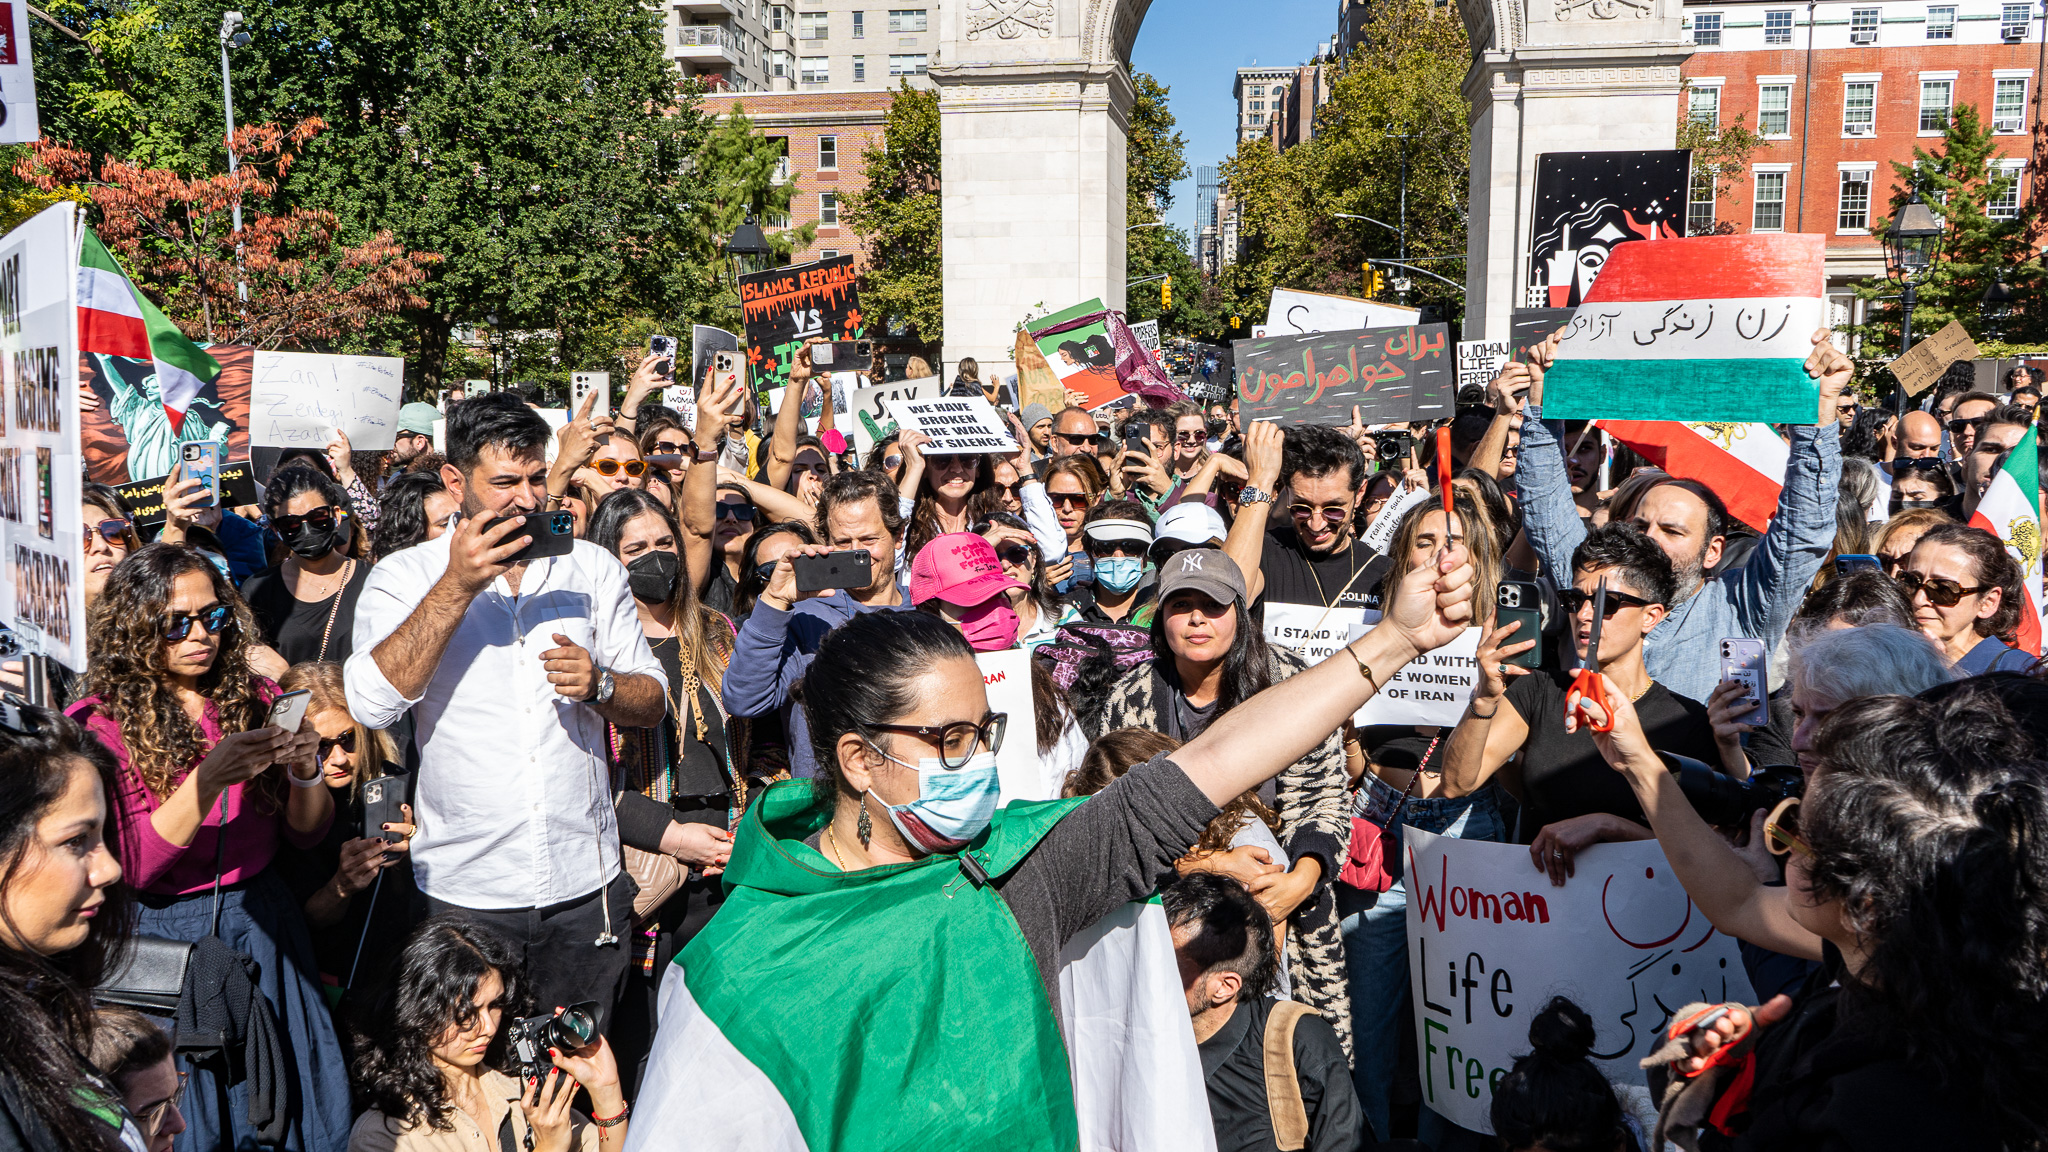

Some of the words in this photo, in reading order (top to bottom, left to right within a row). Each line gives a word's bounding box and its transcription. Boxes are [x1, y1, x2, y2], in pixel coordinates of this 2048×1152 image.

[740, 277, 796, 301] ISLAMIC
[798, 263, 856, 290] REPUBLIC
[790, 308, 823, 334] VS
[1562, 310, 1622, 342] آزادی
[1633, 303, 1714, 346] زندگی
[1736, 304, 1791, 341] زن
[1384, 325, 1445, 361] برای
[1459, 341, 1509, 359] WOMAN
[259, 356, 320, 388] Zan
[1459, 357, 1495, 371] LIFE
[1460, 370, 1501, 385] FREEDO
[907, 404, 933, 414] WE
[935, 402, 973, 413] HAVE
[917, 414, 979, 426] BROKEN
[268, 419, 329, 443] Azadi
[919, 427, 951, 437] THE
[952, 425, 994, 436] WALL
[926, 439, 944, 449] OF
[945, 437, 1007, 448] SILENCE
[1369, 520, 1386, 541] really
[1383, 511, 1392, 521] no
[1390, 494, 1404, 511] such
[1273, 626, 1279, 637] I
[1283, 627, 1331, 640] STAND
[1433, 655, 1477, 668] WITH
[983, 670, 1006, 686] RAN
[1407, 671, 1471, 687] WOMEN
[1387, 688, 1409, 699] OF
[1414, 690, 1455, 702] IRAN
[1408, 845, 1550, 933] Woman
[1420, 936, 1513, 1025] Life
